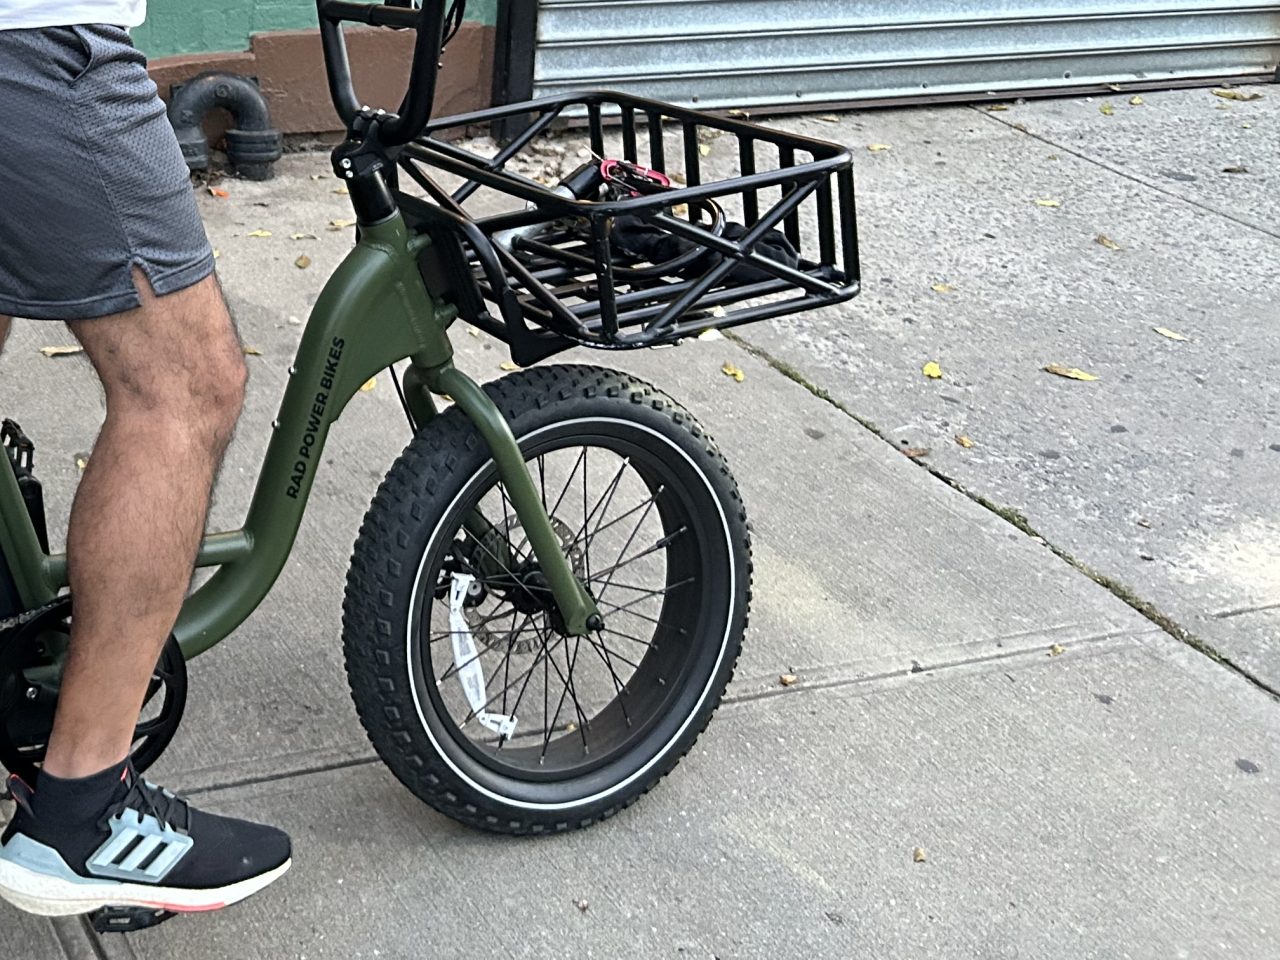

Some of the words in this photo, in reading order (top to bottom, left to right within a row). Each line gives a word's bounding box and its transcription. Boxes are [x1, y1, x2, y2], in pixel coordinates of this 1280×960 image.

[286, 461, 307, 500] RAD
[299, 392, 329, 460] POWER
[321, 335, 346, 391] BIKES
